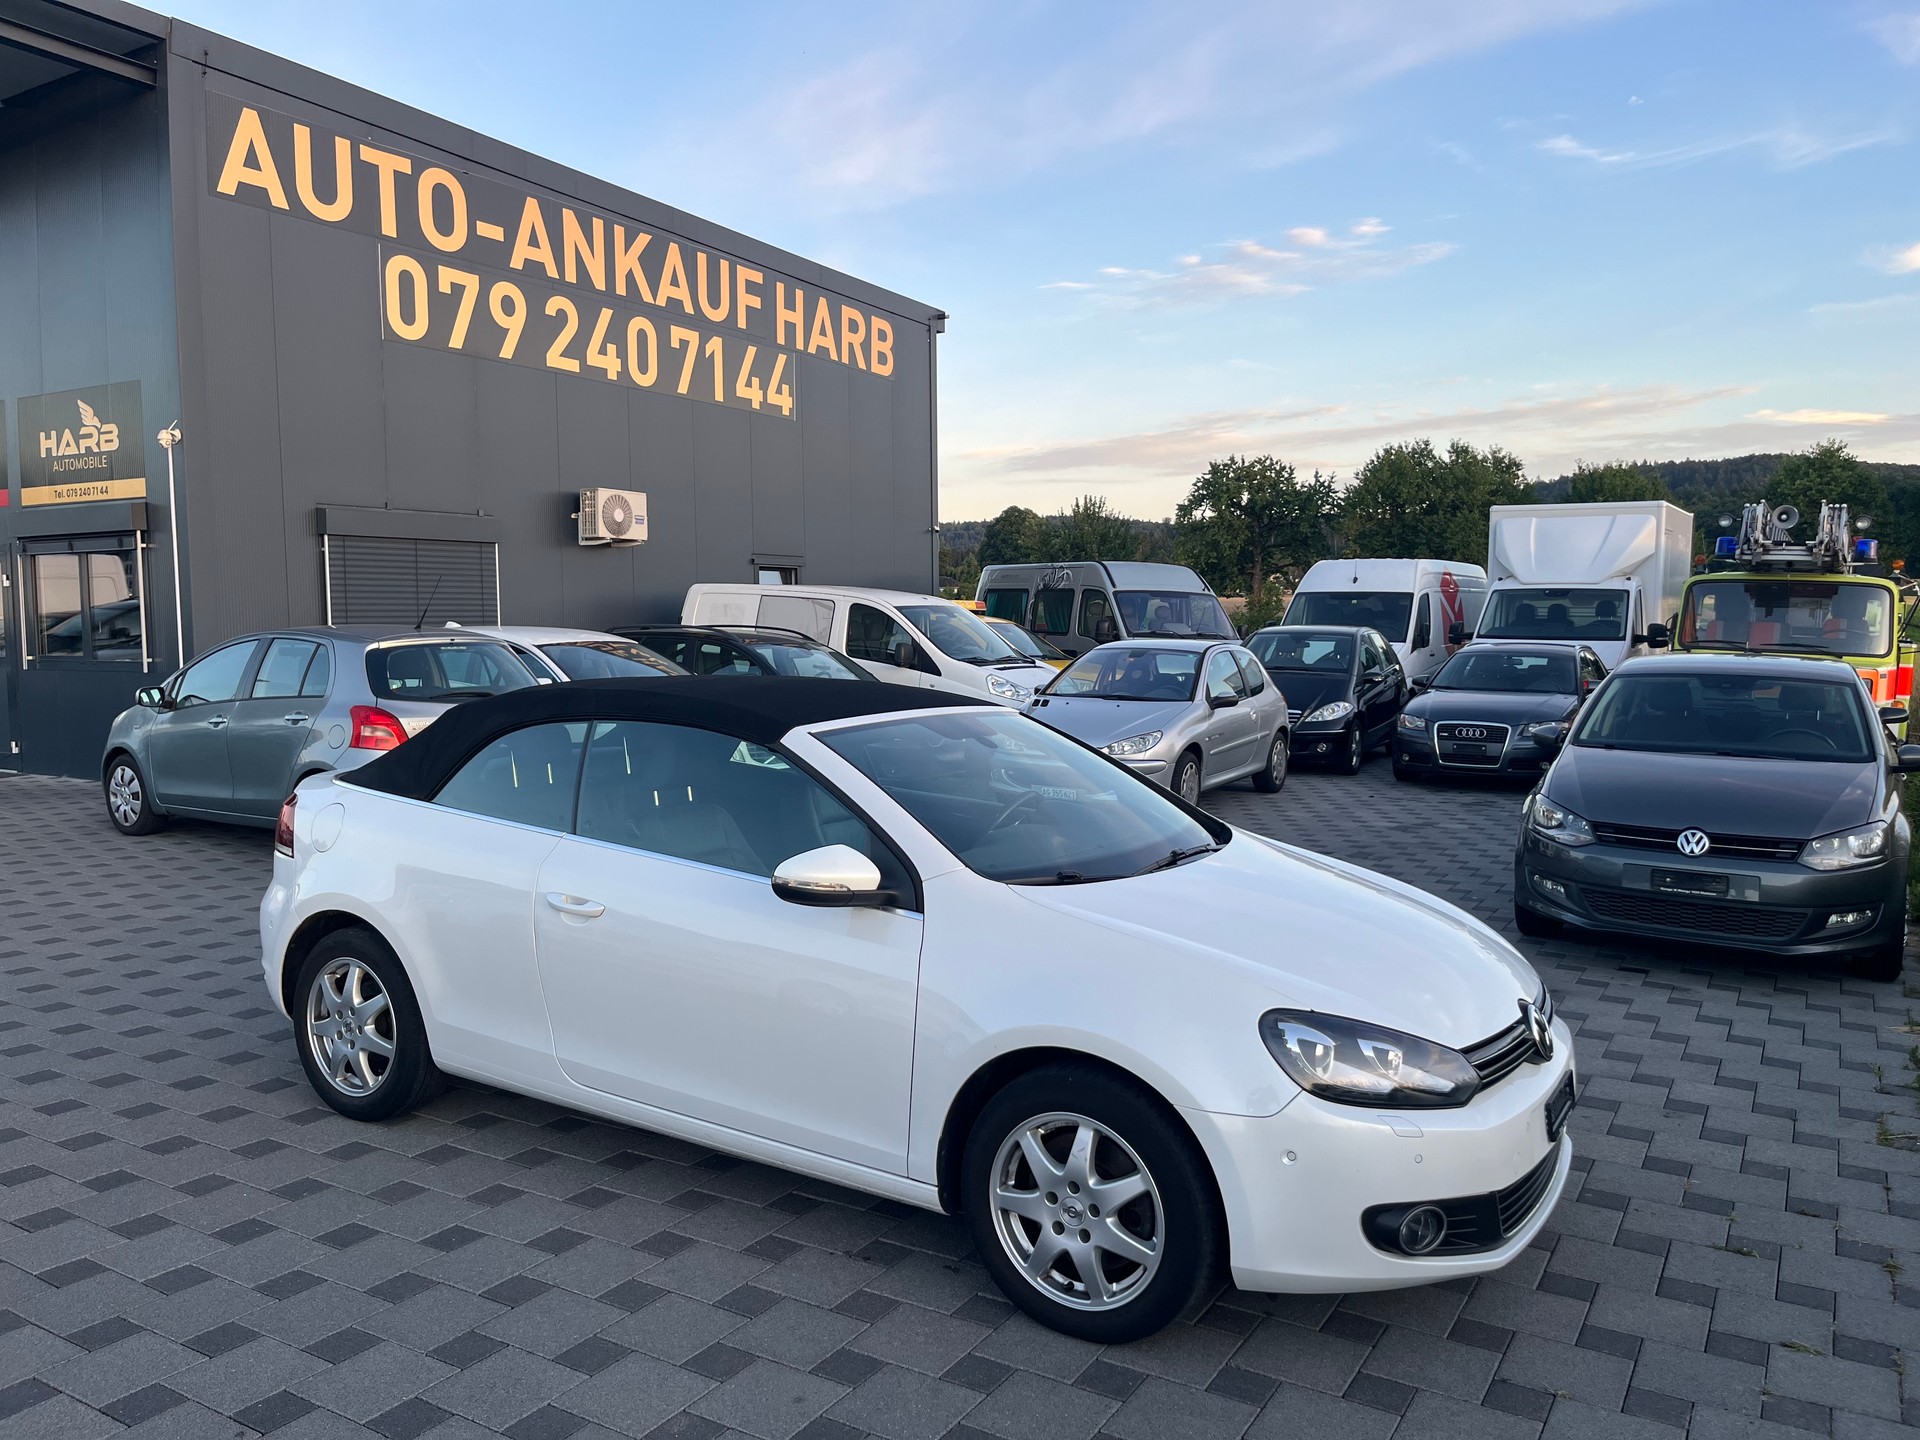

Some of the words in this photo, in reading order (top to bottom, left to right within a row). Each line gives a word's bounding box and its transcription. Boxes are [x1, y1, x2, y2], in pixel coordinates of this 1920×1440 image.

[217, 107, 764, 330] AUTO-ANKAUF
[776, 281, 895, 377] HARB
[39, 423, 120, 458] HARB
[52, 455, 108, 472] AUTOMOBILE
[53, 490, 65, 499] Tel.
